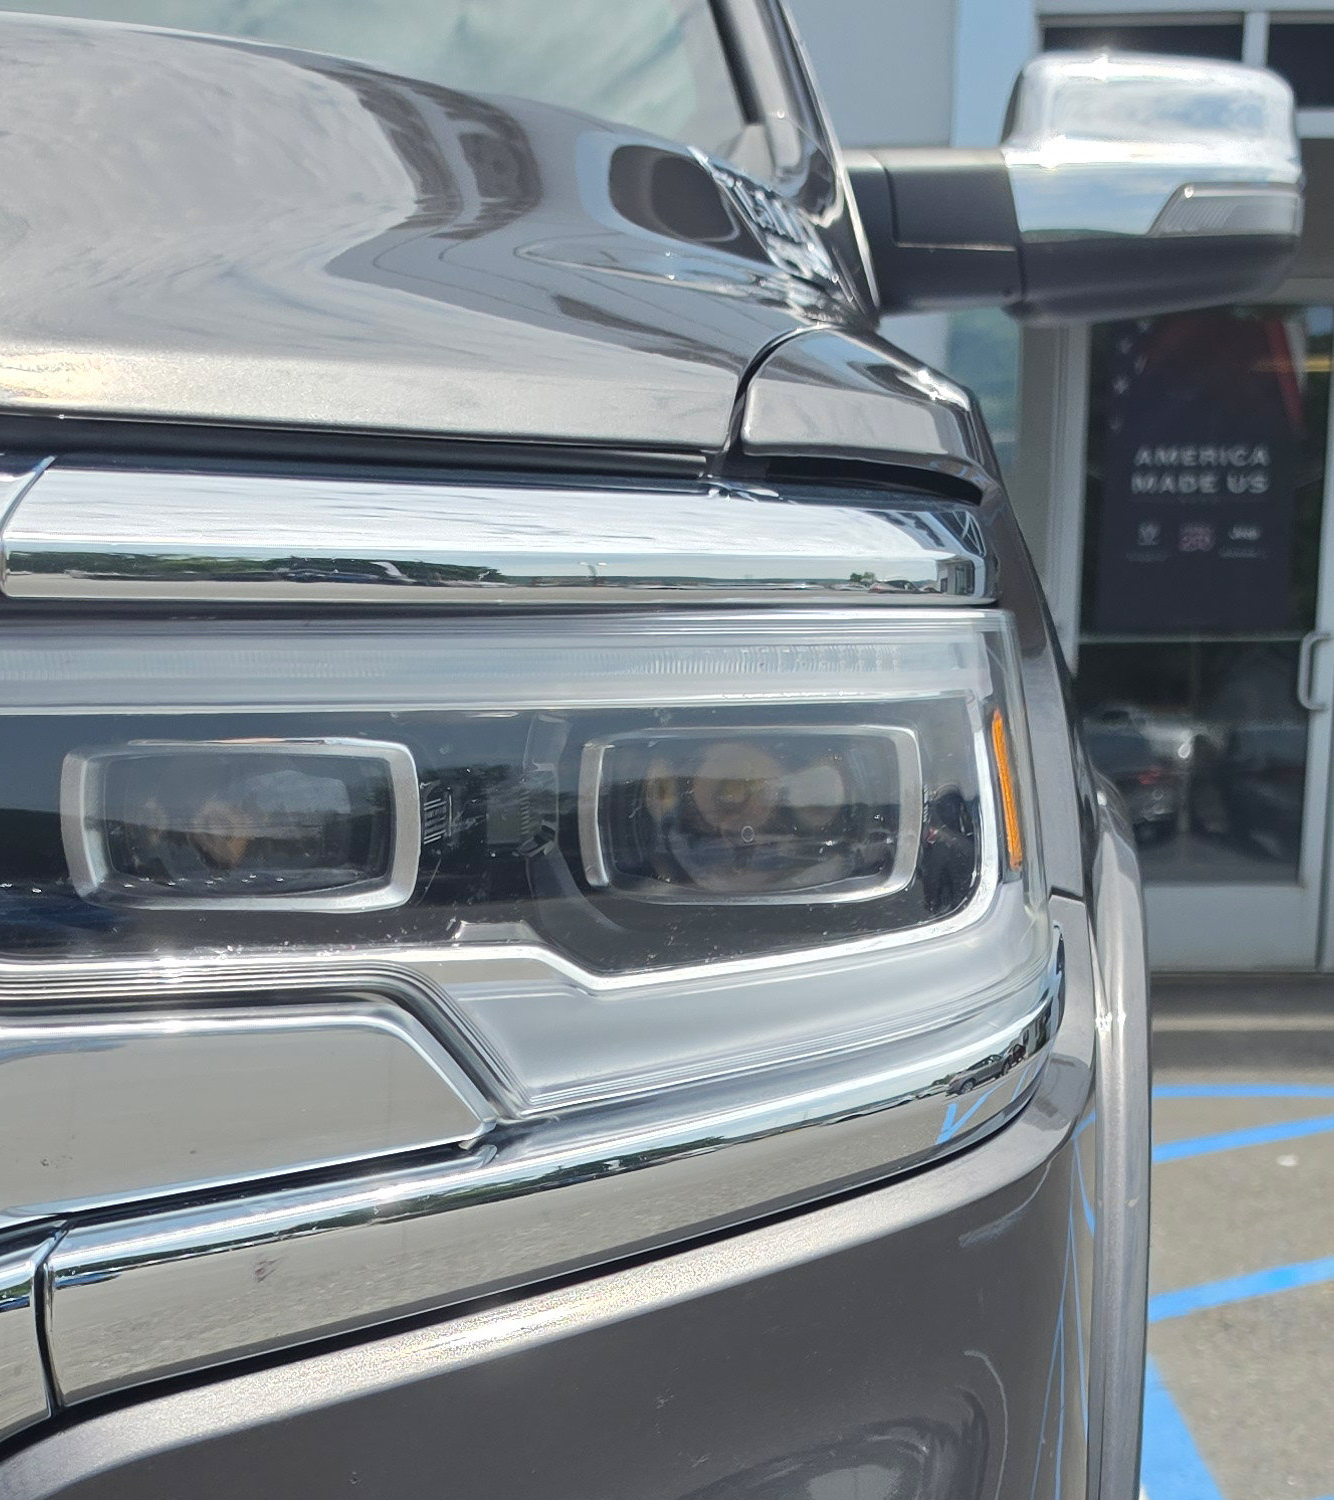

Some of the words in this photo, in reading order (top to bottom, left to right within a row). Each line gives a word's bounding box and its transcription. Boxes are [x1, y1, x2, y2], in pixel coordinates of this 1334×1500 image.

[1133, 444, 1269, 467] AMERICA
[1131, 472, 1218, 494] MADE
[1226, 472, 1269, 494] US
